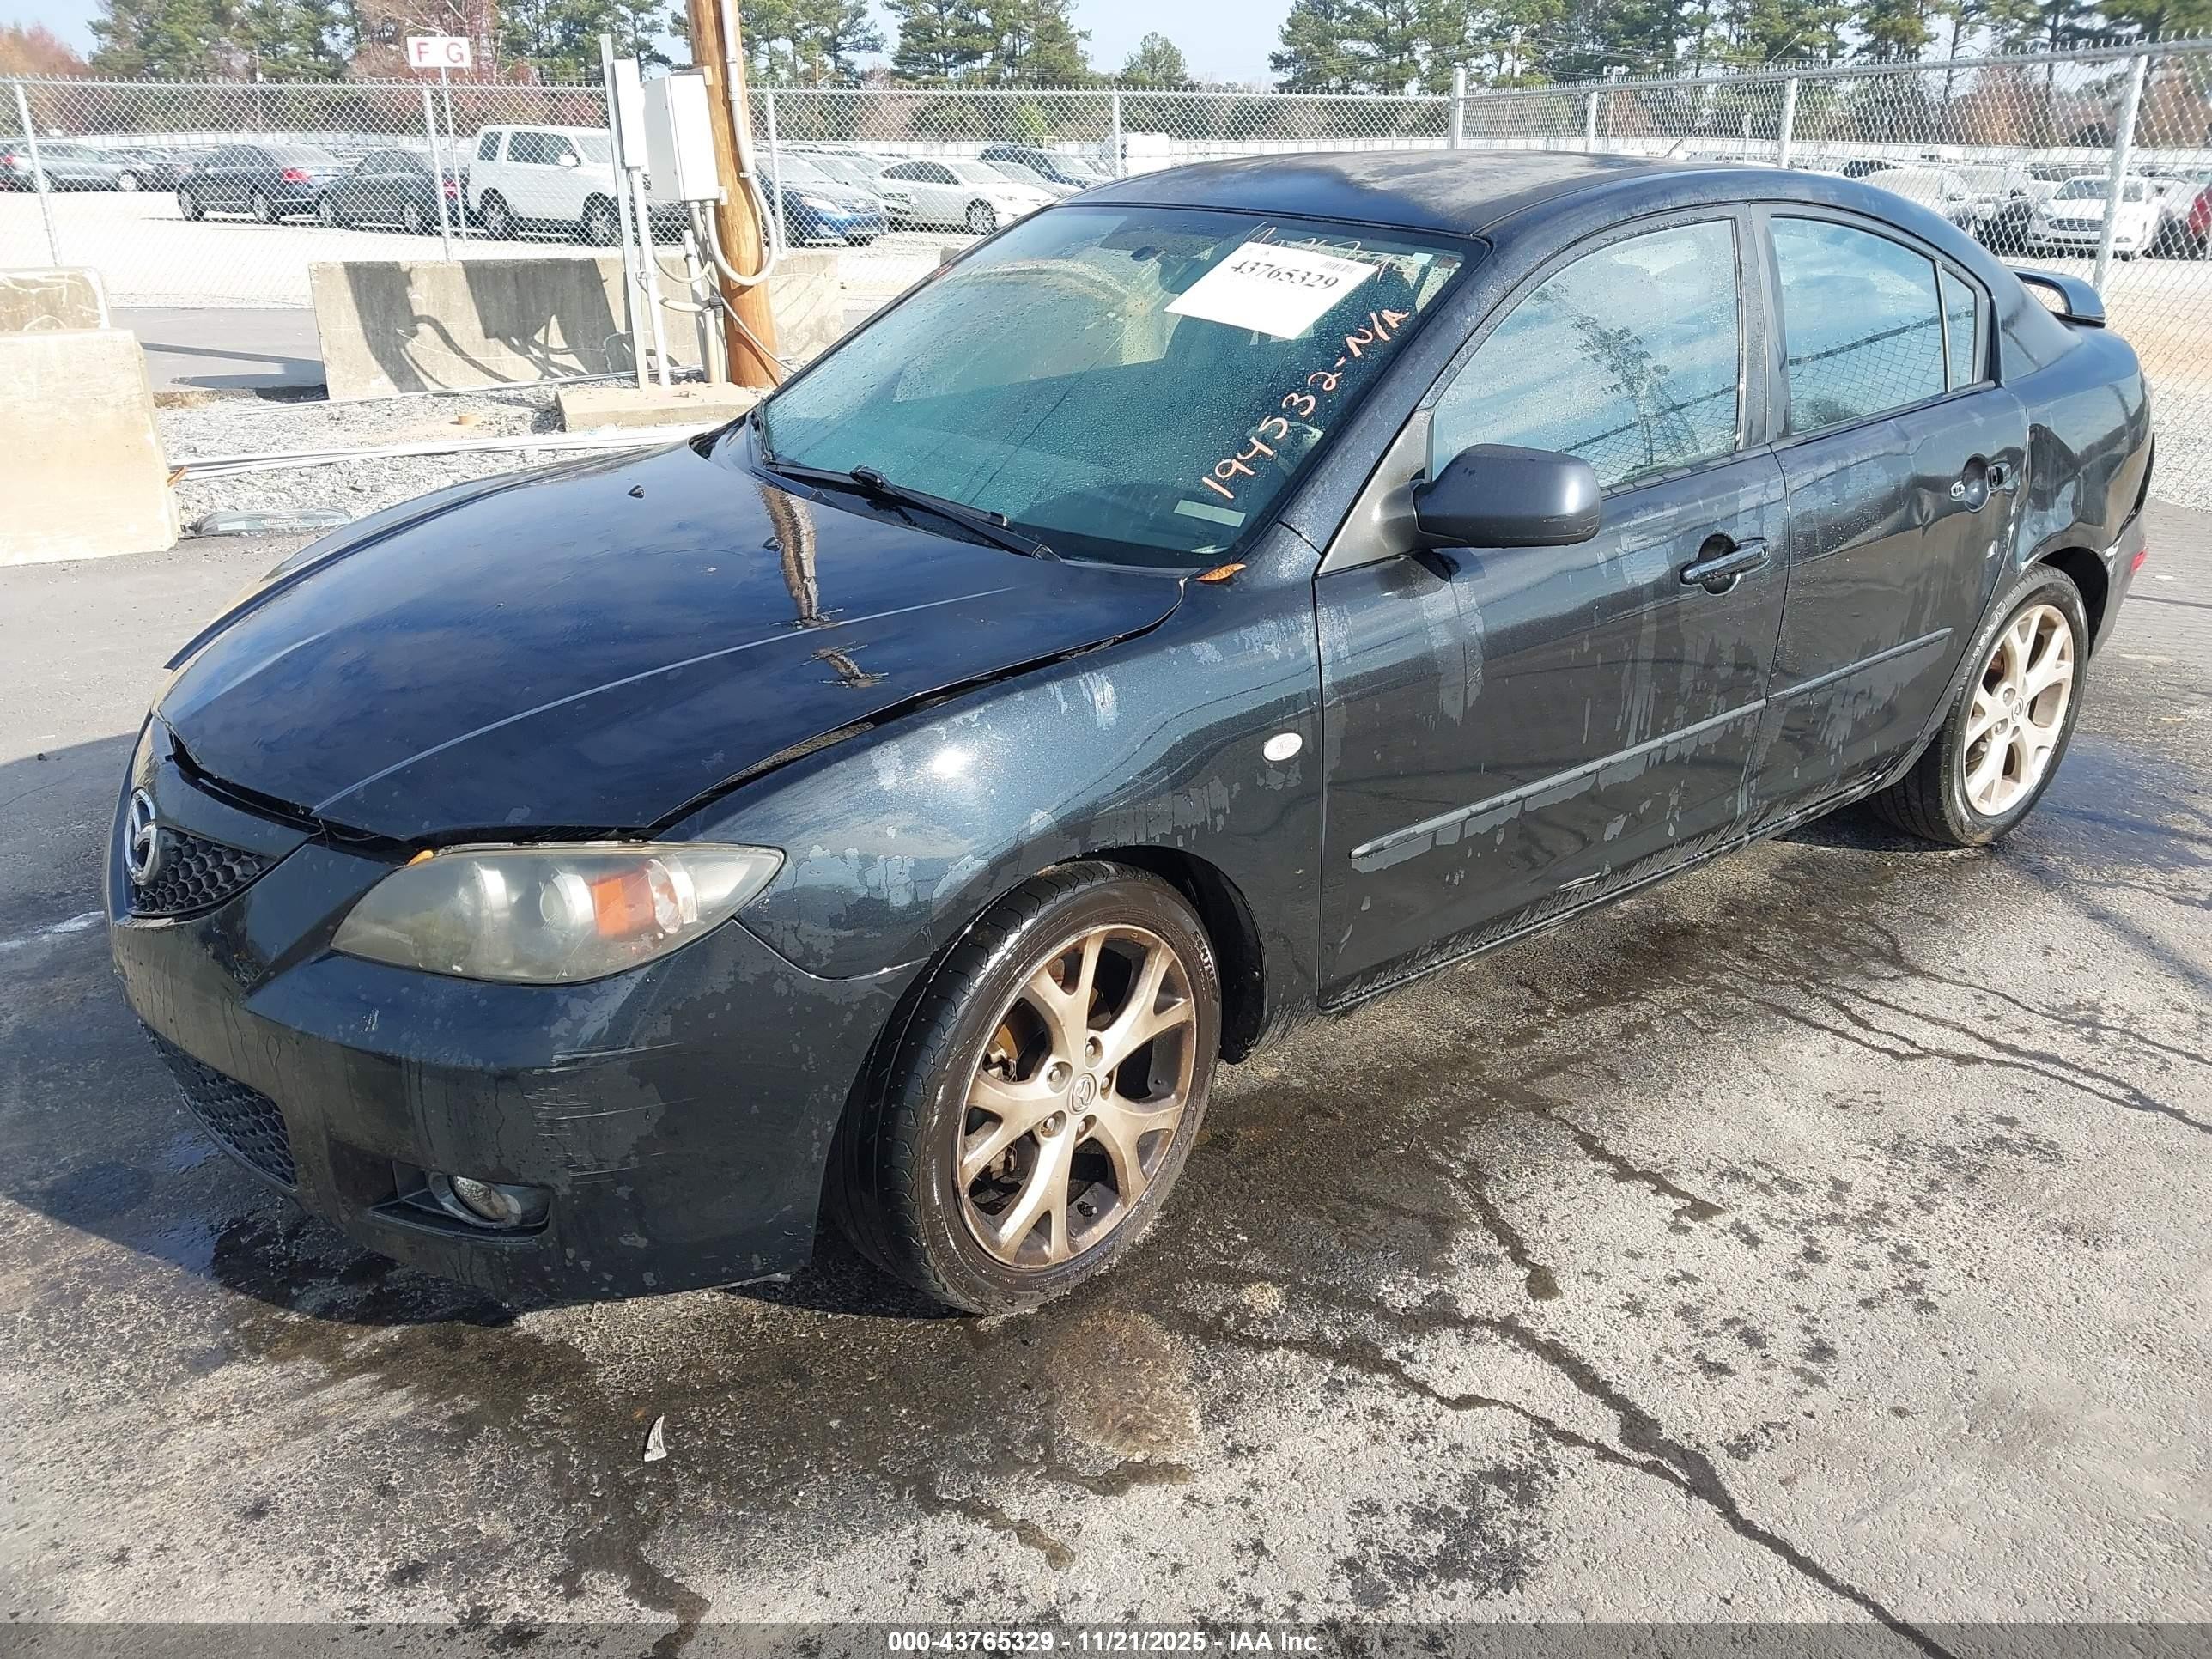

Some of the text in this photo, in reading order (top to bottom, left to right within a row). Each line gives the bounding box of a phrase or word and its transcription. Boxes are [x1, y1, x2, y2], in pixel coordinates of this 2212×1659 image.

[416, 41, 465, 64] F G
[1230, 259, 1340, 289] 43765329
